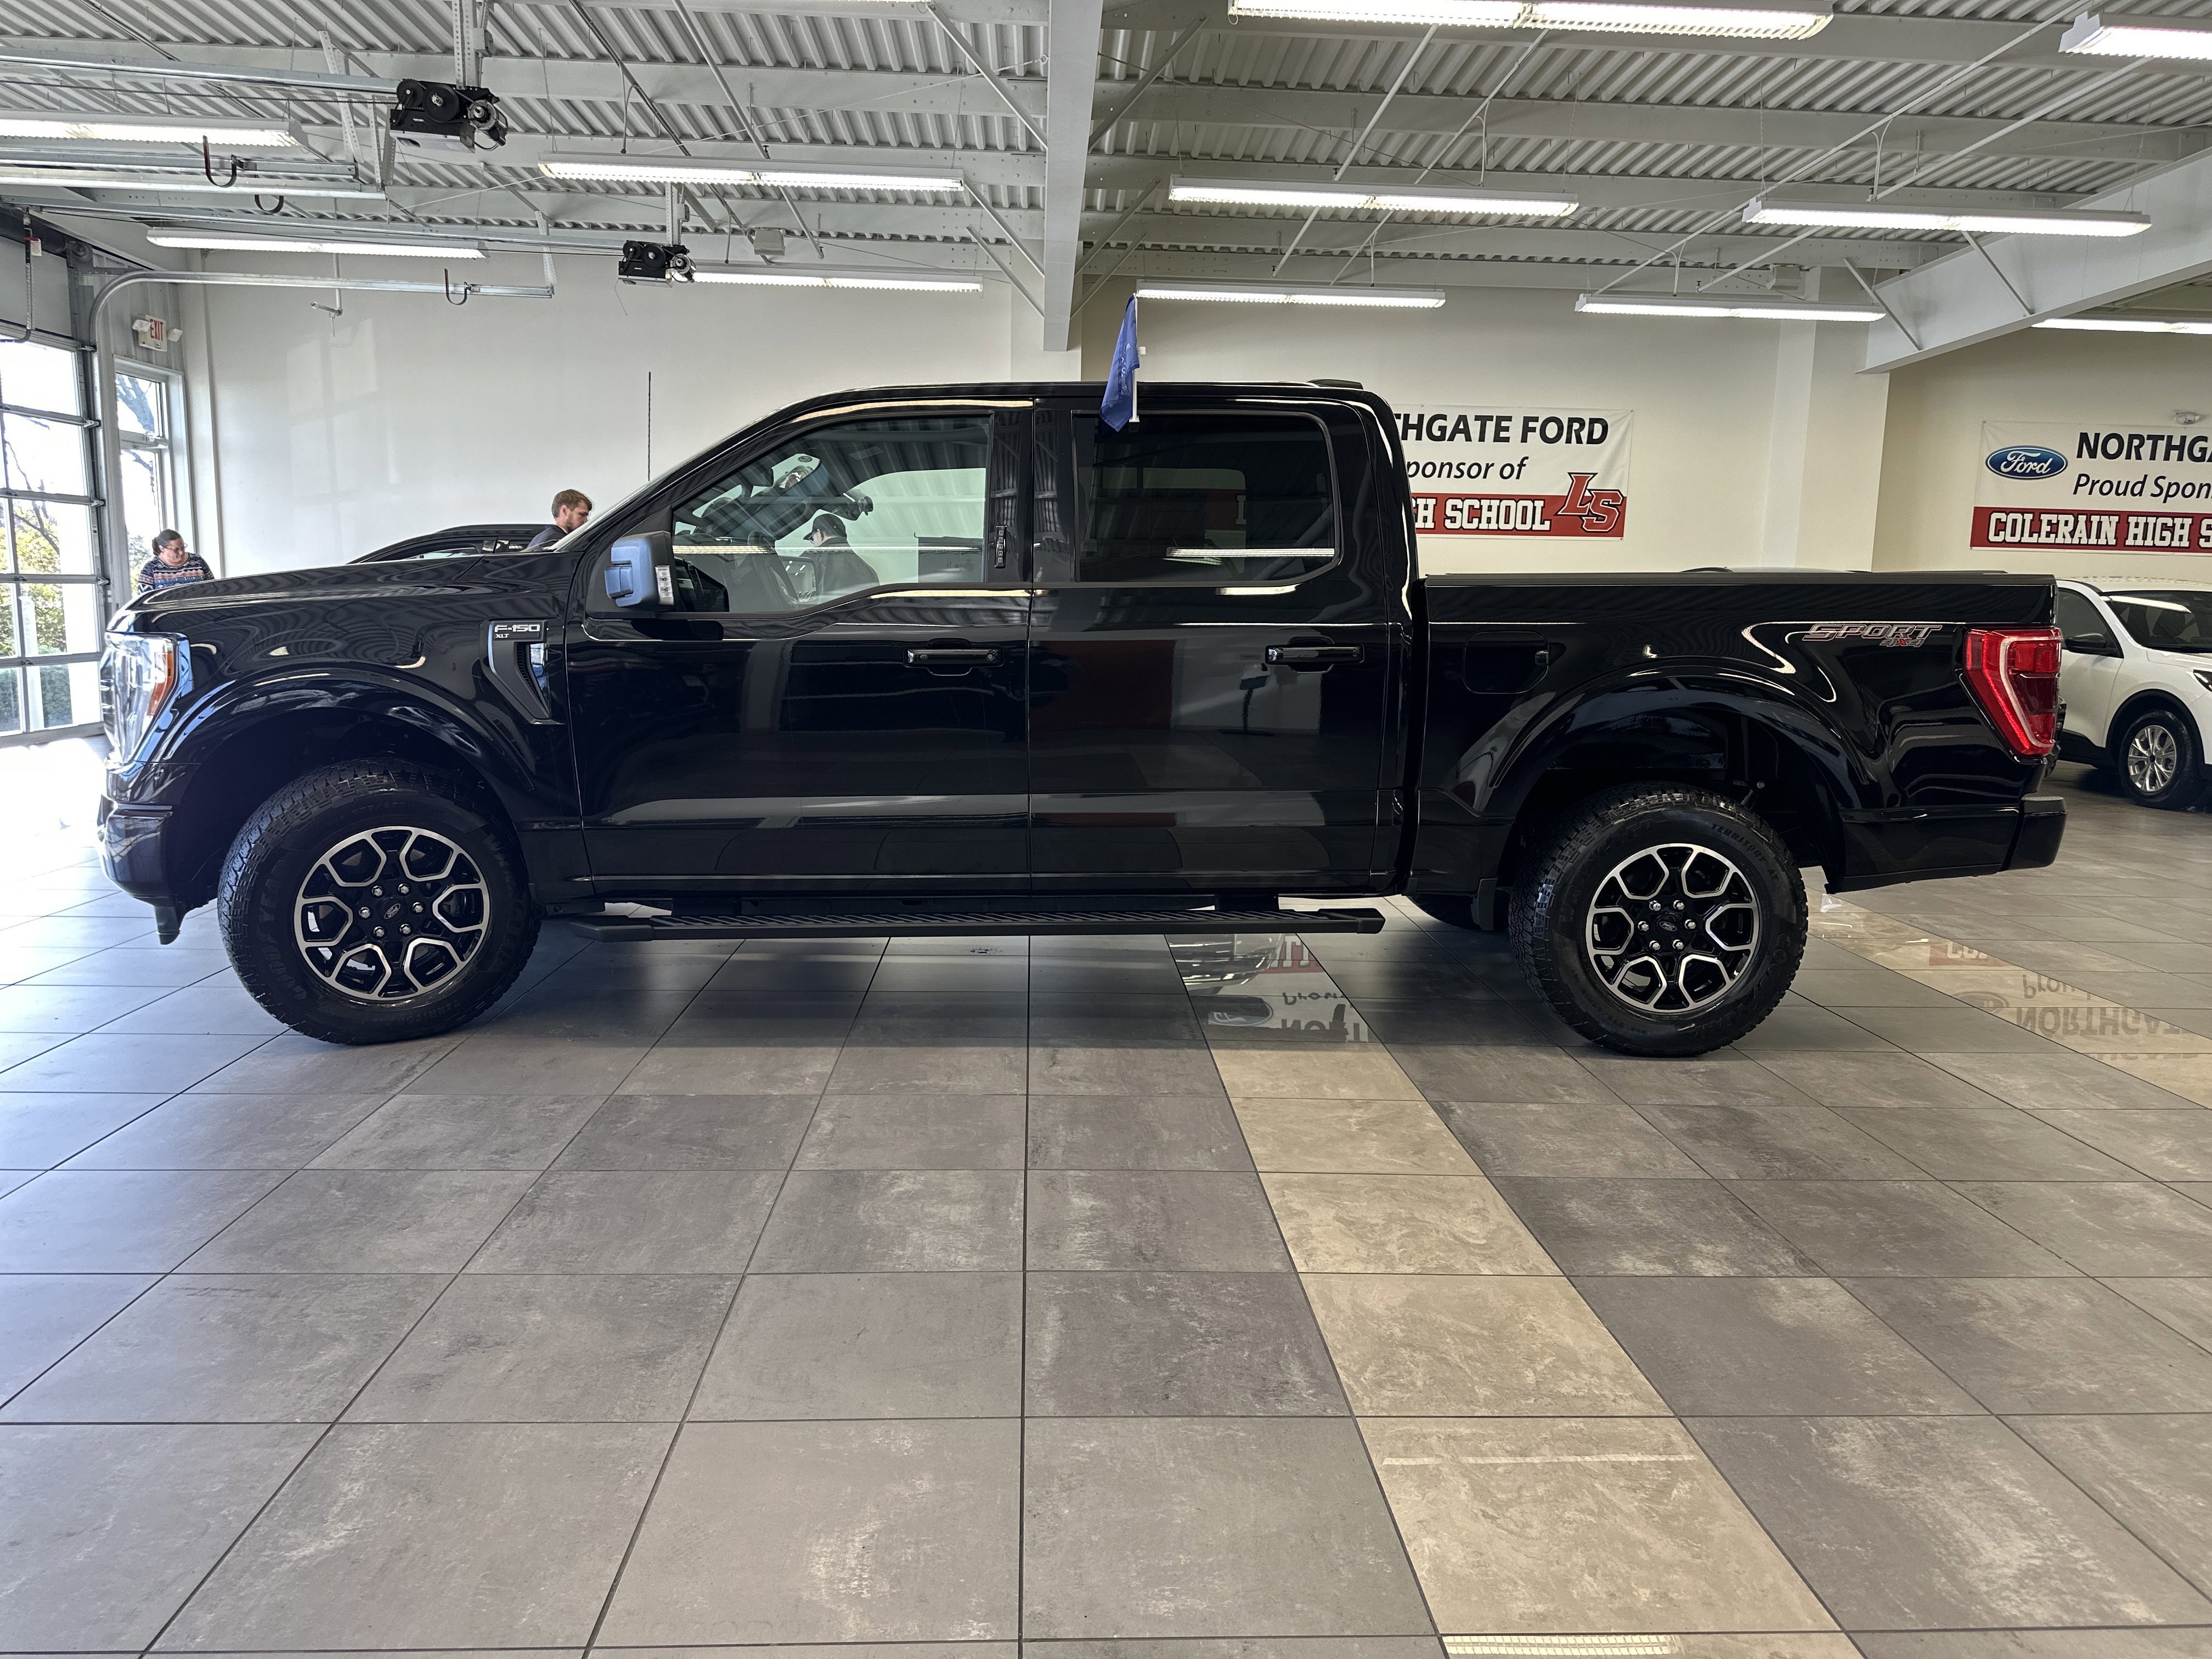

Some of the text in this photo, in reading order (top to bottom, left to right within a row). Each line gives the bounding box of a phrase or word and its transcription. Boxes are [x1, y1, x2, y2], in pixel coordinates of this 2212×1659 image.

[150, 319, 163, 341] EXIT
[1520, 416, 1609, 445] FORD
[2076, 432, 2212, 463] NORTHG
[1499, 456, 1530, 480] of
[2000, 450, 2052, 475] Ford
[2073, 473, 2148, 497] Proud
[1444, 498, 1551, 531] SCHOOL
[1988, 511, 2119, 546] COLERAIN
[2125, 516, 2192, 548] HIGH
[495, 624, 540, 633] F-150
[1802, 624, 1943, 641] SPORT
